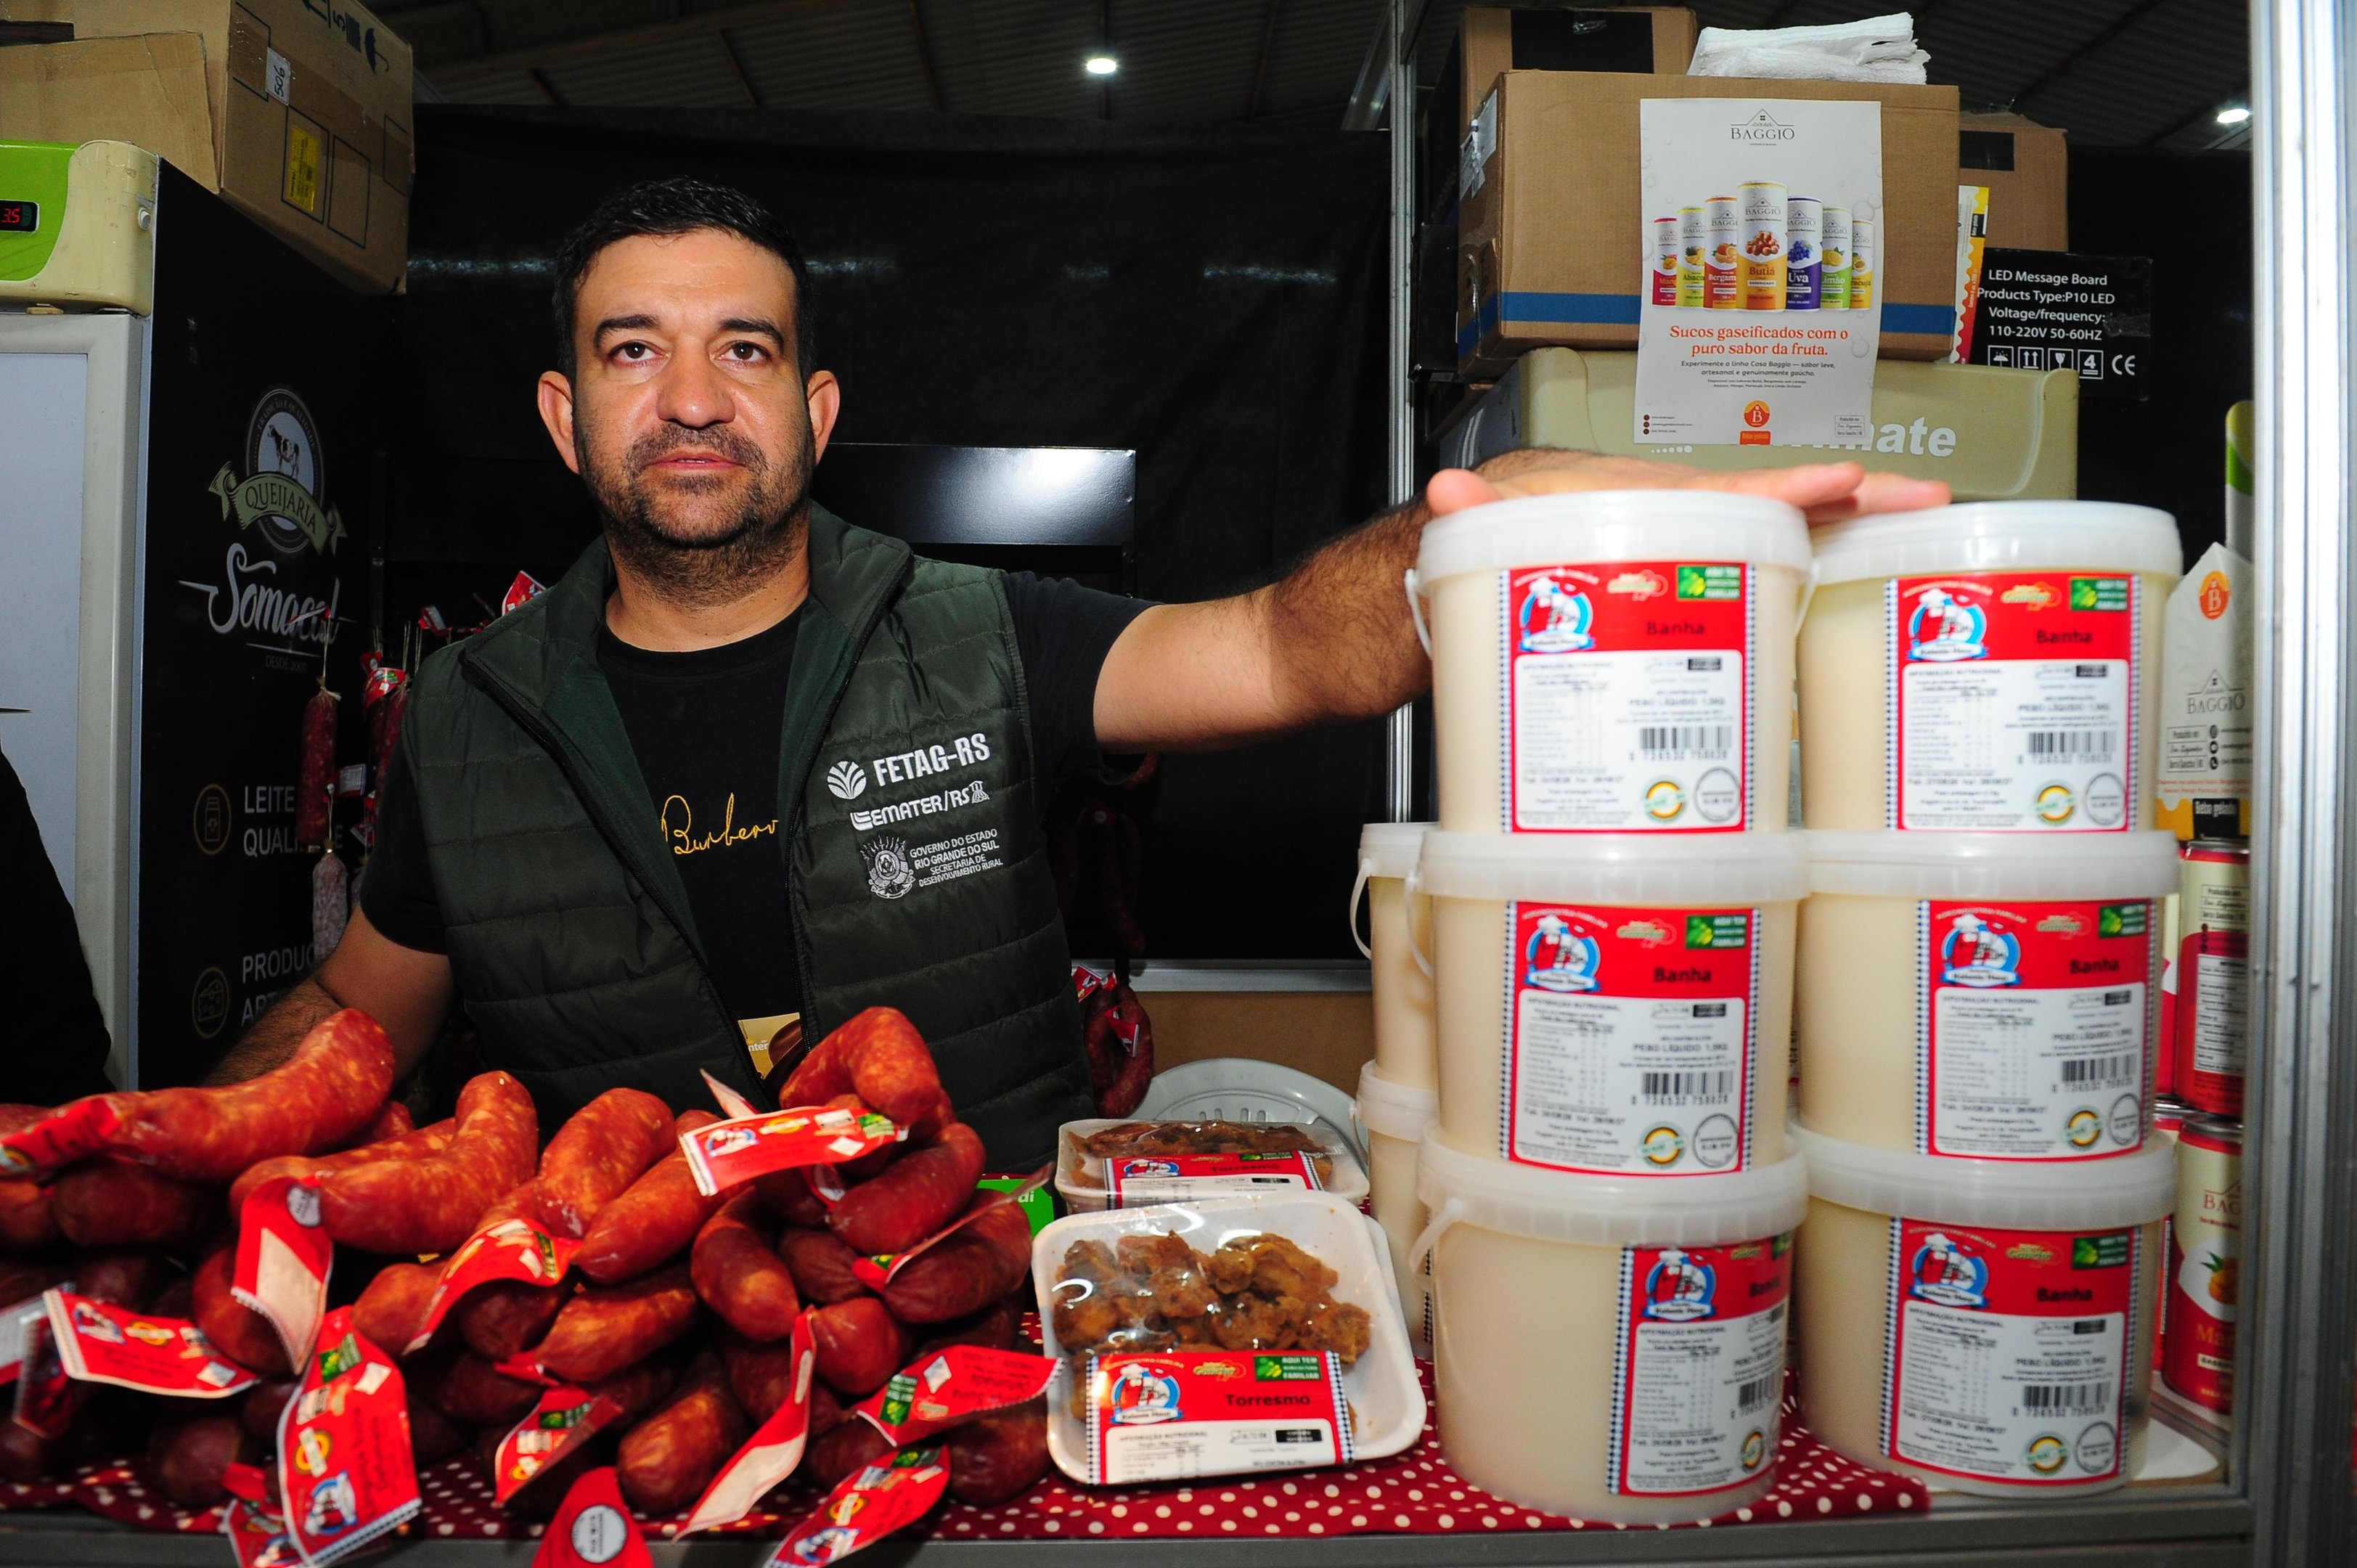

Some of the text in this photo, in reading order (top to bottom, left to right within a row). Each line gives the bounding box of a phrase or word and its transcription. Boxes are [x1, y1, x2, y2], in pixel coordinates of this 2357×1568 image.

[273, 65, 286, 97] 506
[1731, 127, 1795, 140] BAGGIO
[1708, 273, 1737, 282] Bergam
[1749, 266, 1776, 277] Butiá
[1788, 271, 1809, 283] Uva
[1989, 269, 2012, 281] LED
[2015, 271, 2069, 285] Message
[2072, 274, 2108, 286] Board
[1977, 287, 2115, 305] Products Type:P10 LED
[1989, 306, 2106, 324] Voltage/frequency:
[1670, 325, 1849, 341] Sucos gaseificados com o
[1990, 324, 2103, 341] 110-220V 50-60HZ
[1691, 342, 1829, 357] puro sabor da fruta.
[245, 482, 319, 534] QUEIJARIA
[1646, 621, 1704, 636] Banha
[2036, 629, 2093, 645] Banha
[2187, 693, 2246, 716] BAGGIO
[873, 732, 992, 787] FETAG-RS
[244, 785, 295, 814] LEITE
[910, 828, 997, 858] GOVERNO DO ESTADO
[915, 840, 1000, 870] RIO GRANDE DO SUL
[918, 858, 1003, 887] DESENVOLVIMENTO RURAL
[930, 854, 986, 875] SECRETARIA DE
[1654, 967, 1712, 983] Banha
[2071, 959, 2120, 975] Banha
[2204, 1193, 2242, 1215] BAG
[2036, 1287, 2093, 1303] Banha
[1225, 1394, 1311, 1407] Torresmo
